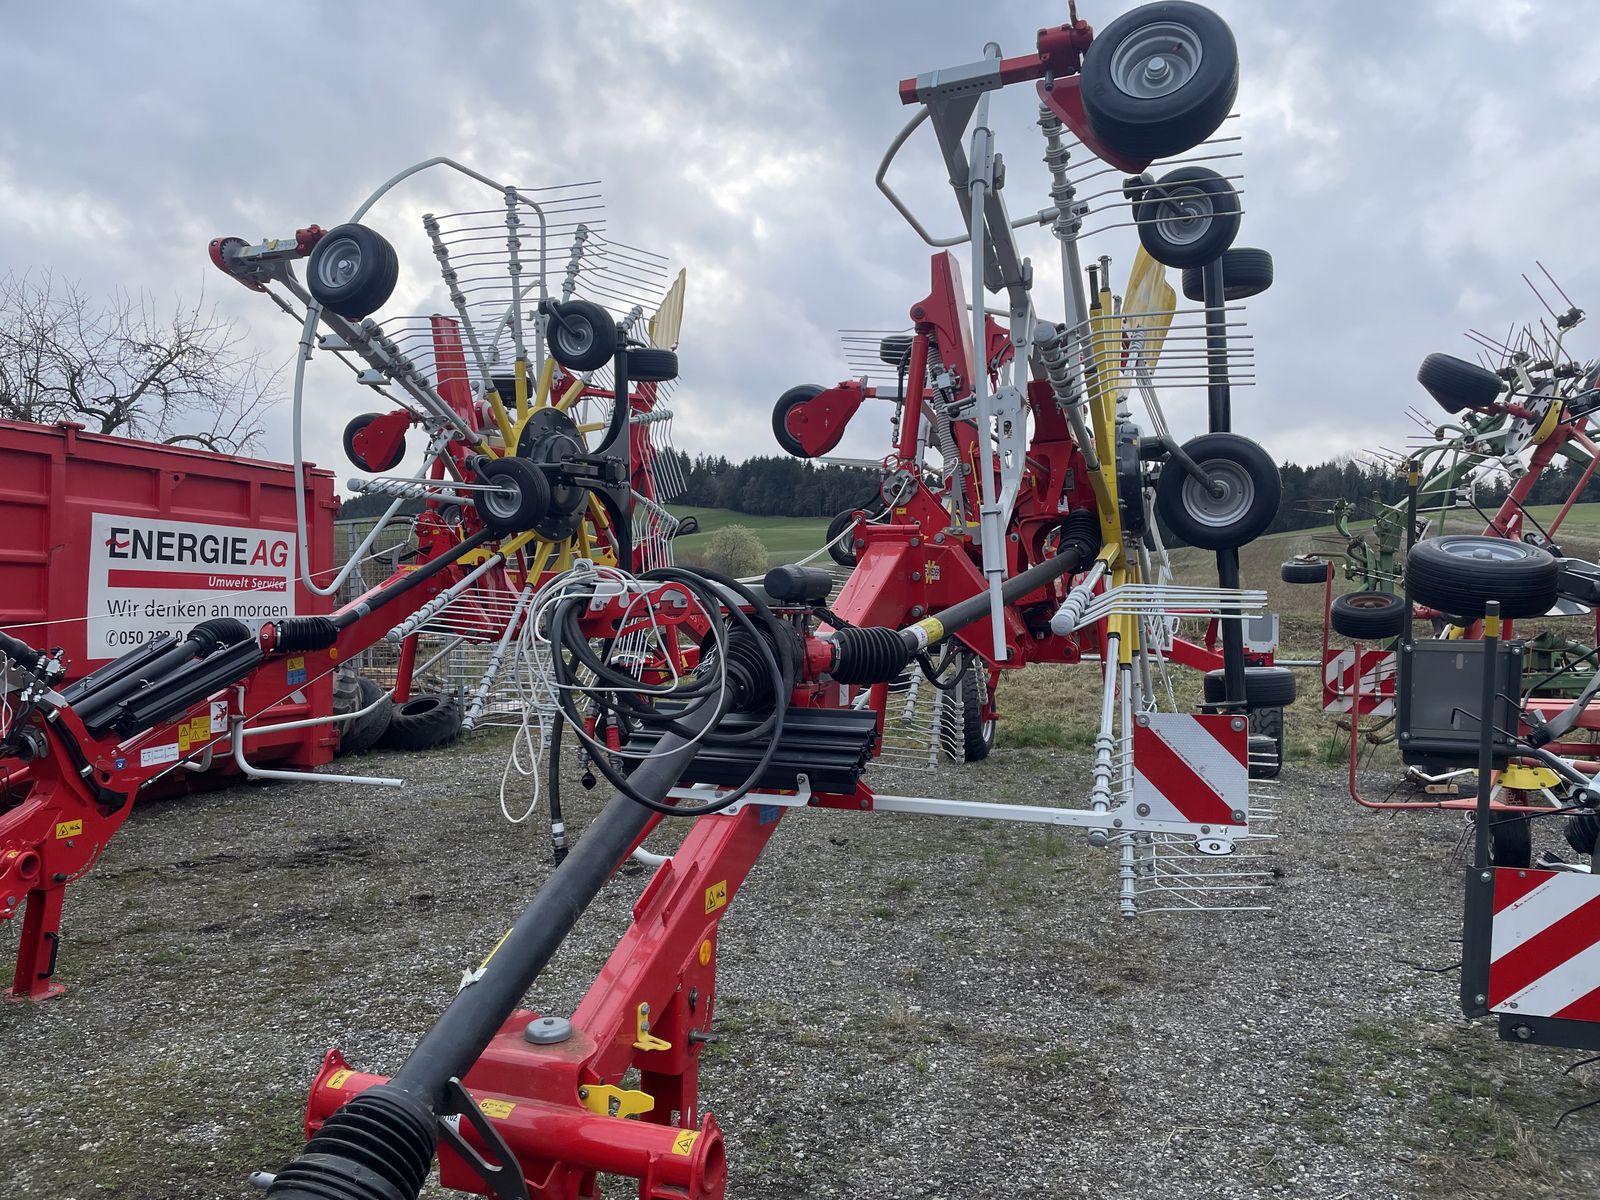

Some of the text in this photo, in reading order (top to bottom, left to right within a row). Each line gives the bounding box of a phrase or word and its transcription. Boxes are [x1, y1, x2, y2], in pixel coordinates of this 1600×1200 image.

[105, 527, 289, 568] ENERGIE AG
[208, 575, 285, 590] Umwelt Service
[107, 599, 289, 617] Wir denken an morgen
[119, 630, 144, 645] 050
